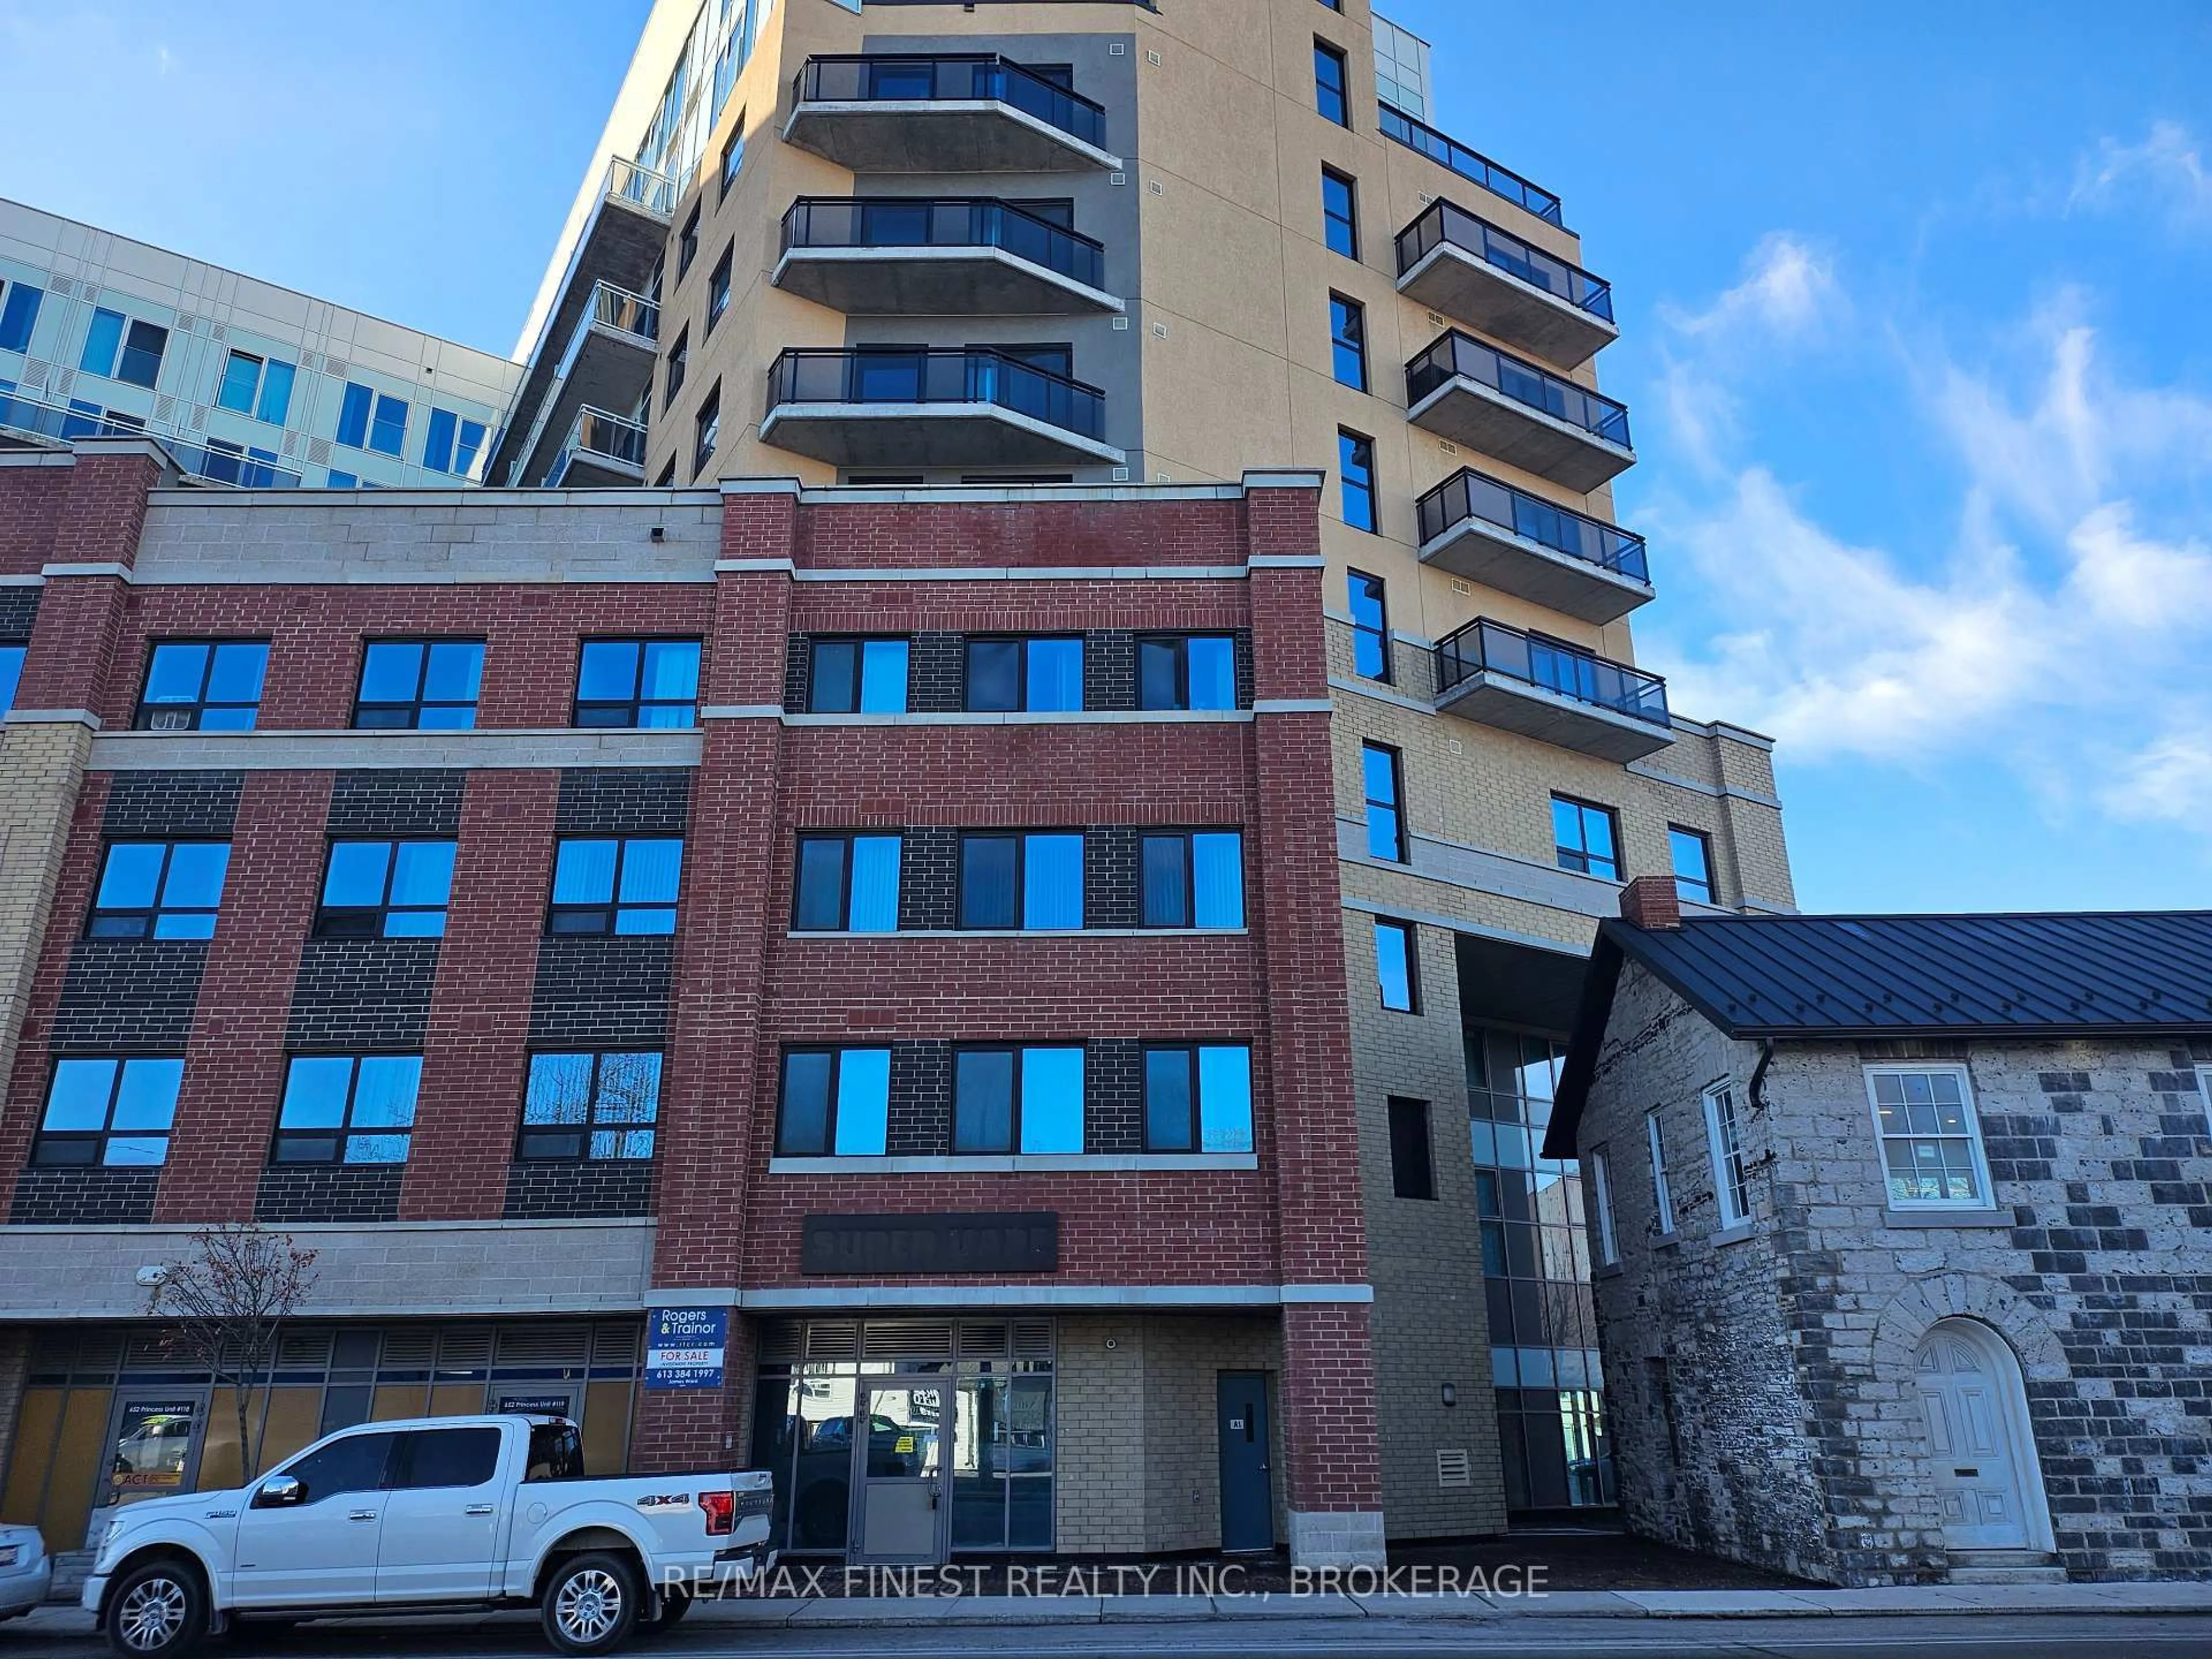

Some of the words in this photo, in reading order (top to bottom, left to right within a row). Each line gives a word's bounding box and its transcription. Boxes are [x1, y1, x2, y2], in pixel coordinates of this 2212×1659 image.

[662, 1309, 706, 1323] Rogers
[661, 1323, 670, 1334] &
[672, 1322, 716, 1334] Trainor
[661, 1351, 681, 1361] FOR
[684, 1351, 709, 1361] SALE
[657, 1370, 673, 1379] 613
[675, 1369, 691, 1378] 384
[694, 1369, 714, 1378] 1997
